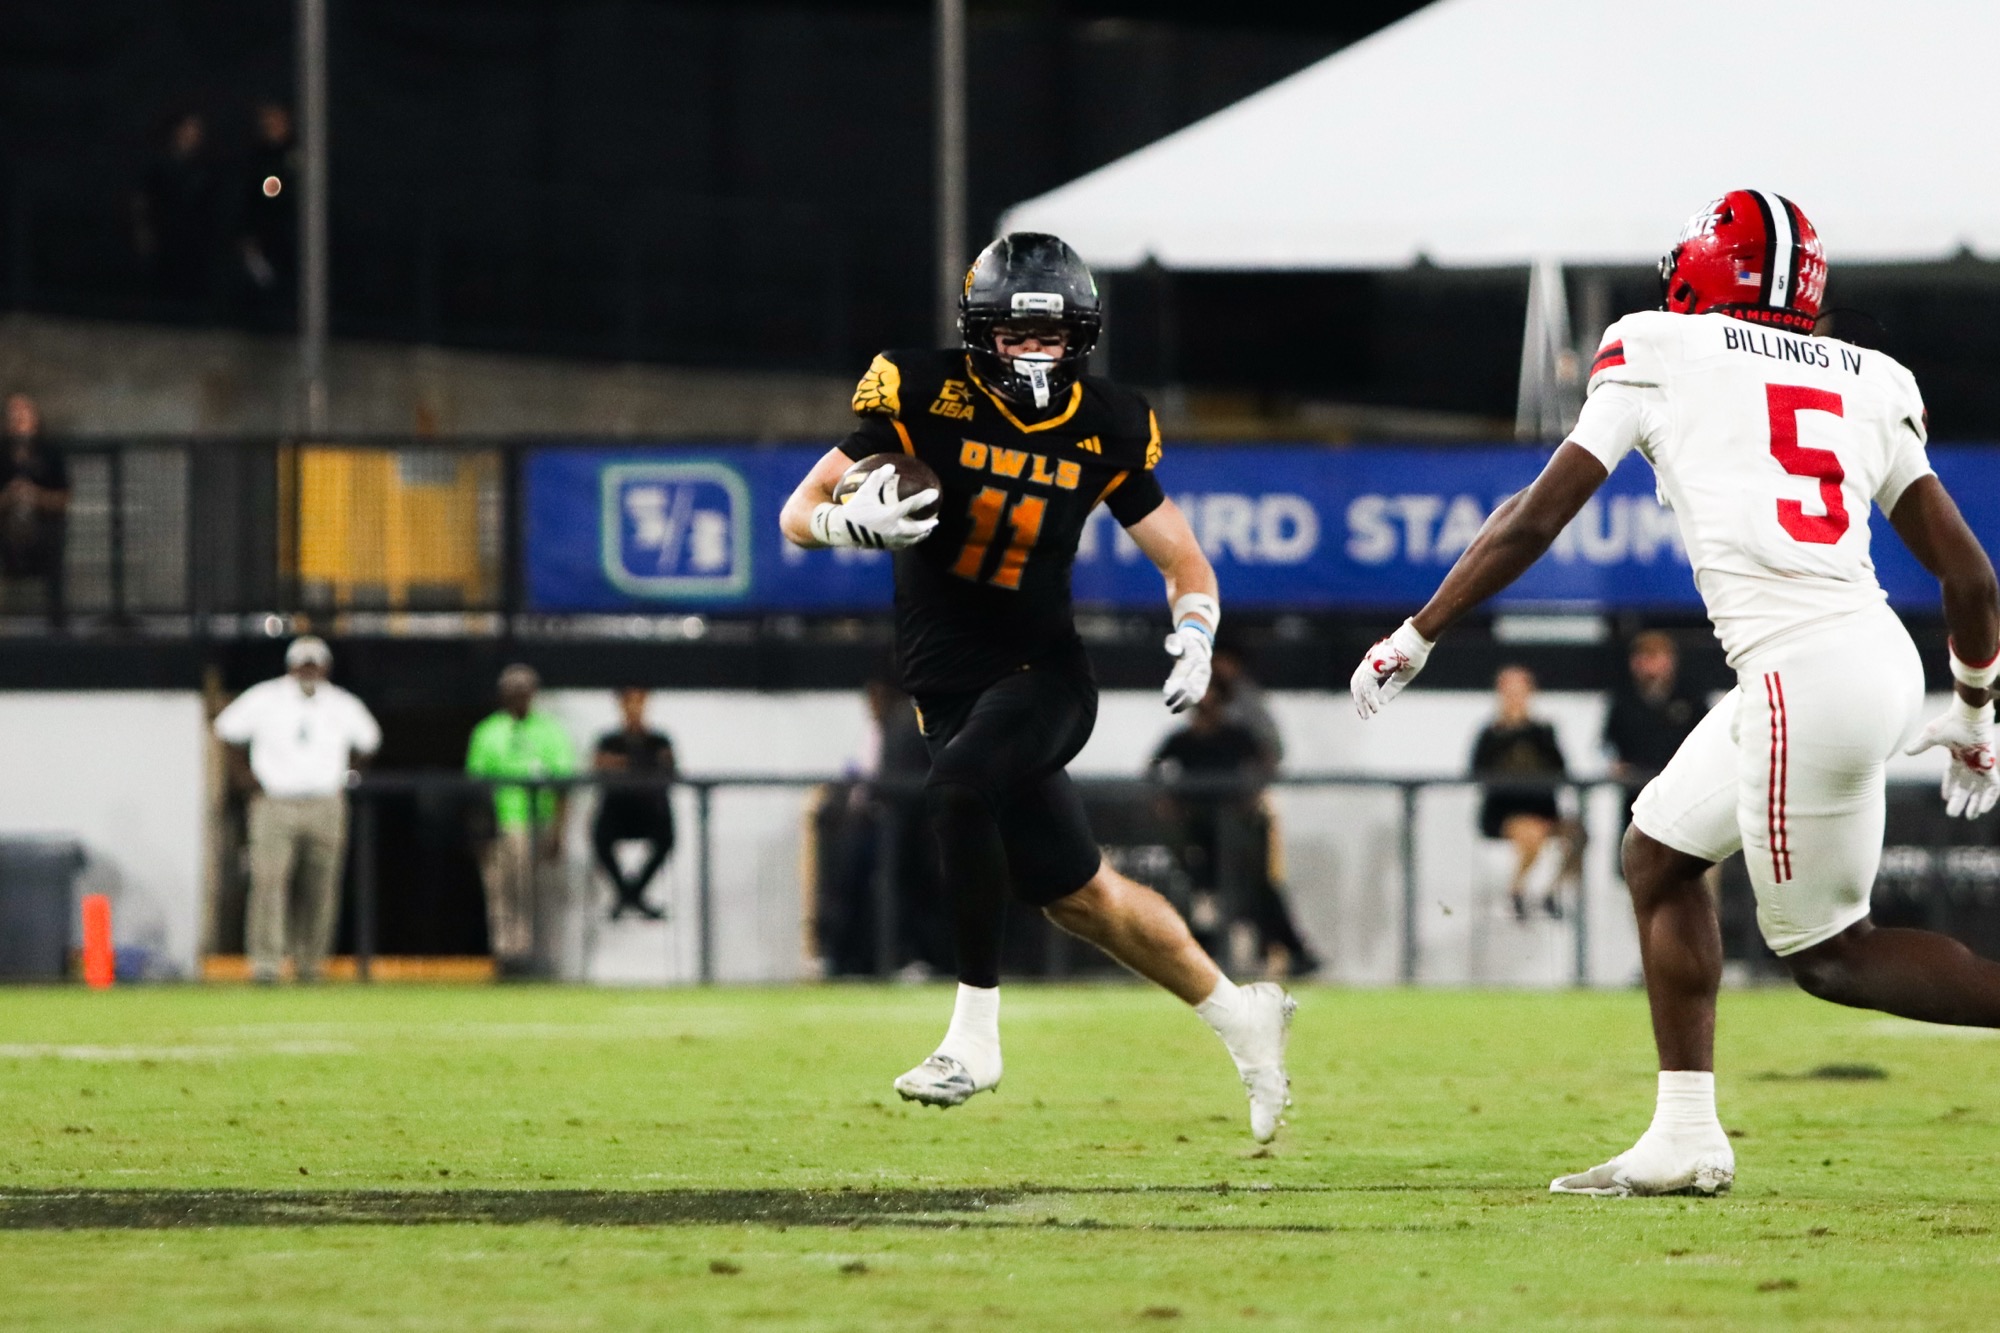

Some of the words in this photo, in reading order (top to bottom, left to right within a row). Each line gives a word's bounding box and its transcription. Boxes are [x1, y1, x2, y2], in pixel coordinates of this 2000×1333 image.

[1778, 275, 1785, 290] 5
[1723, 326, 1830, 369] BILLINGS
[1841, 348, 1862, 376] IV
[929, 399, 975, 421] USA
[959, 437, 1082, 490] OWLS
[1764, 383, 1850, 545] 5
[949, 485, 1048, 590] 11
